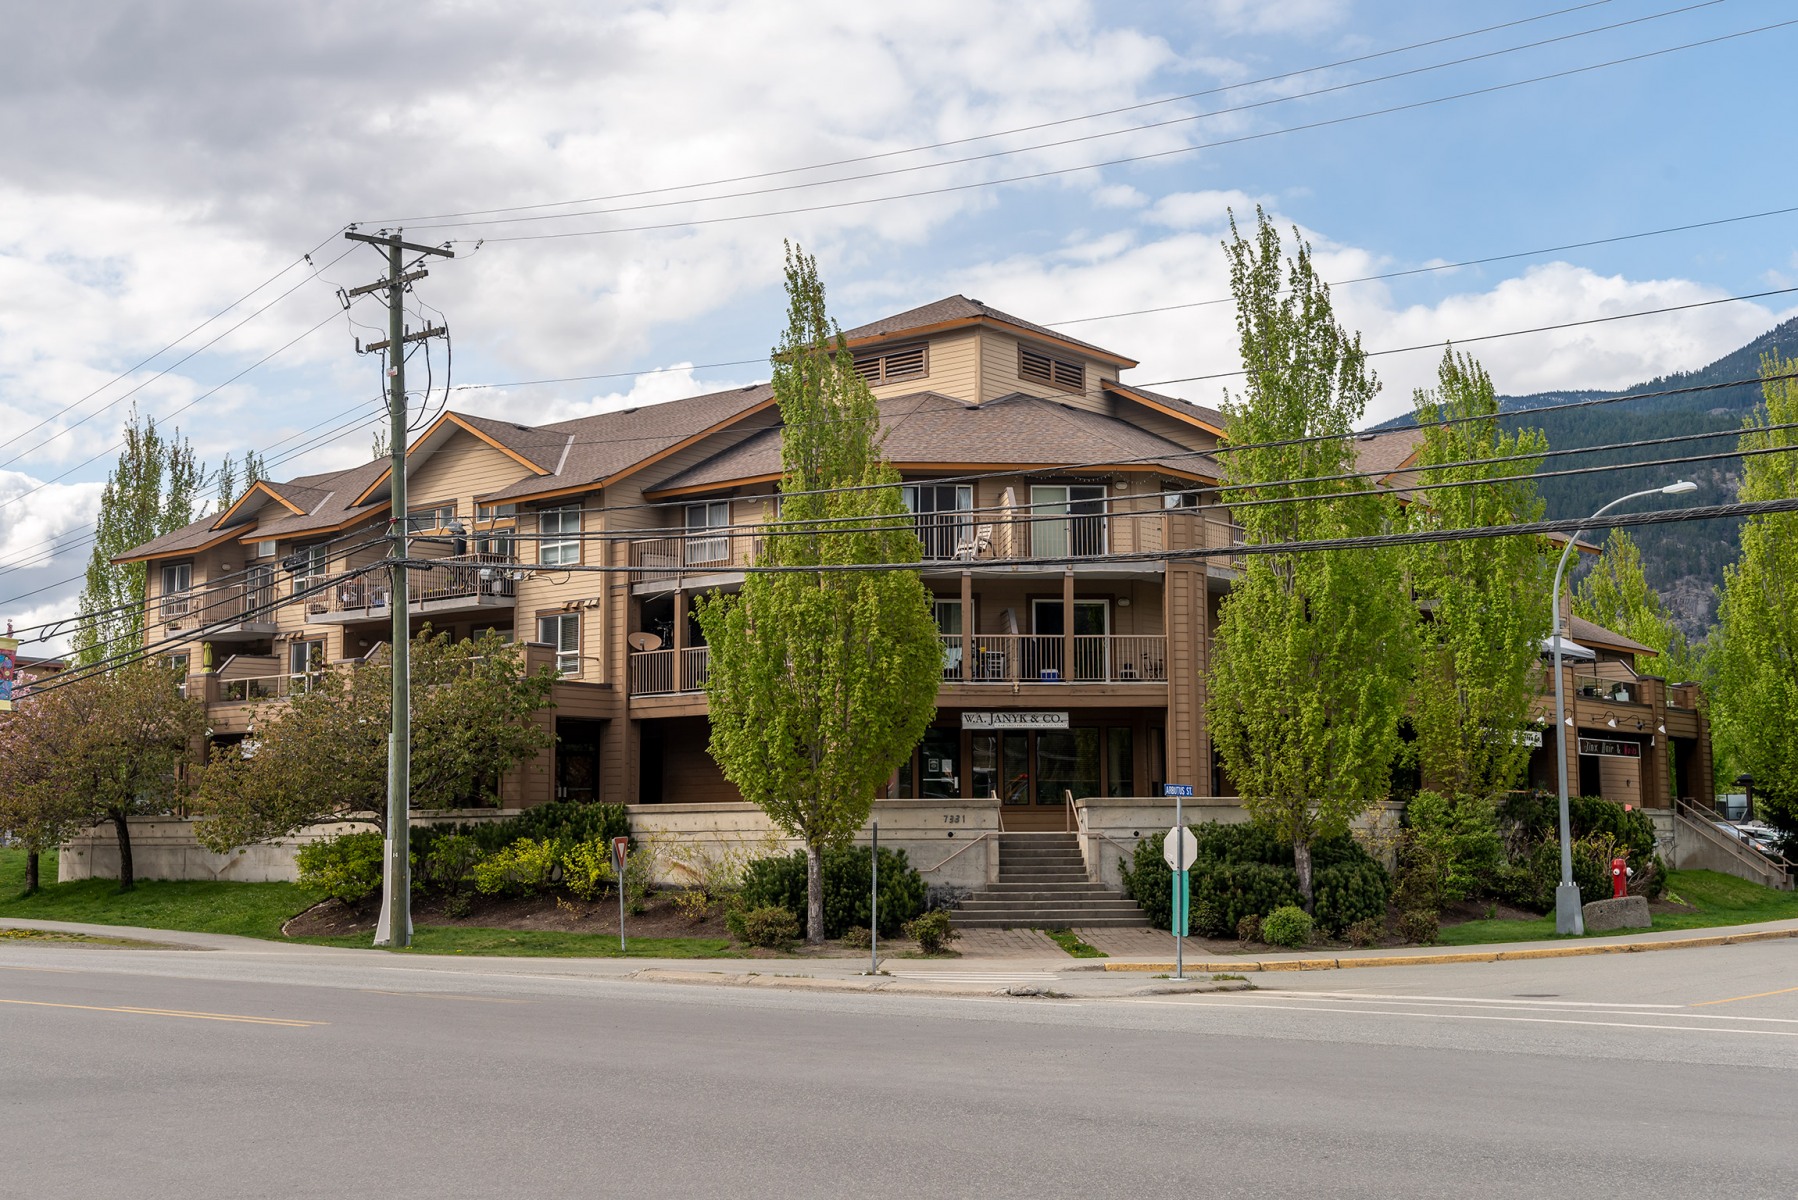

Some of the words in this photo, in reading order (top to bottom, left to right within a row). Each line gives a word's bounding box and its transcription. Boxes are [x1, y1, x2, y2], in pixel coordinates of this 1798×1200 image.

[964, 714, 987, 723] W.A.
[988, 712, 1028, 726] JANYK
[1030, 713, 1039, 723] &
[1042, 713, 1064, 723] CO.
[1166, 785, 1185, 795] ARBUTUS
[943, 814, 965, 823] 7331
